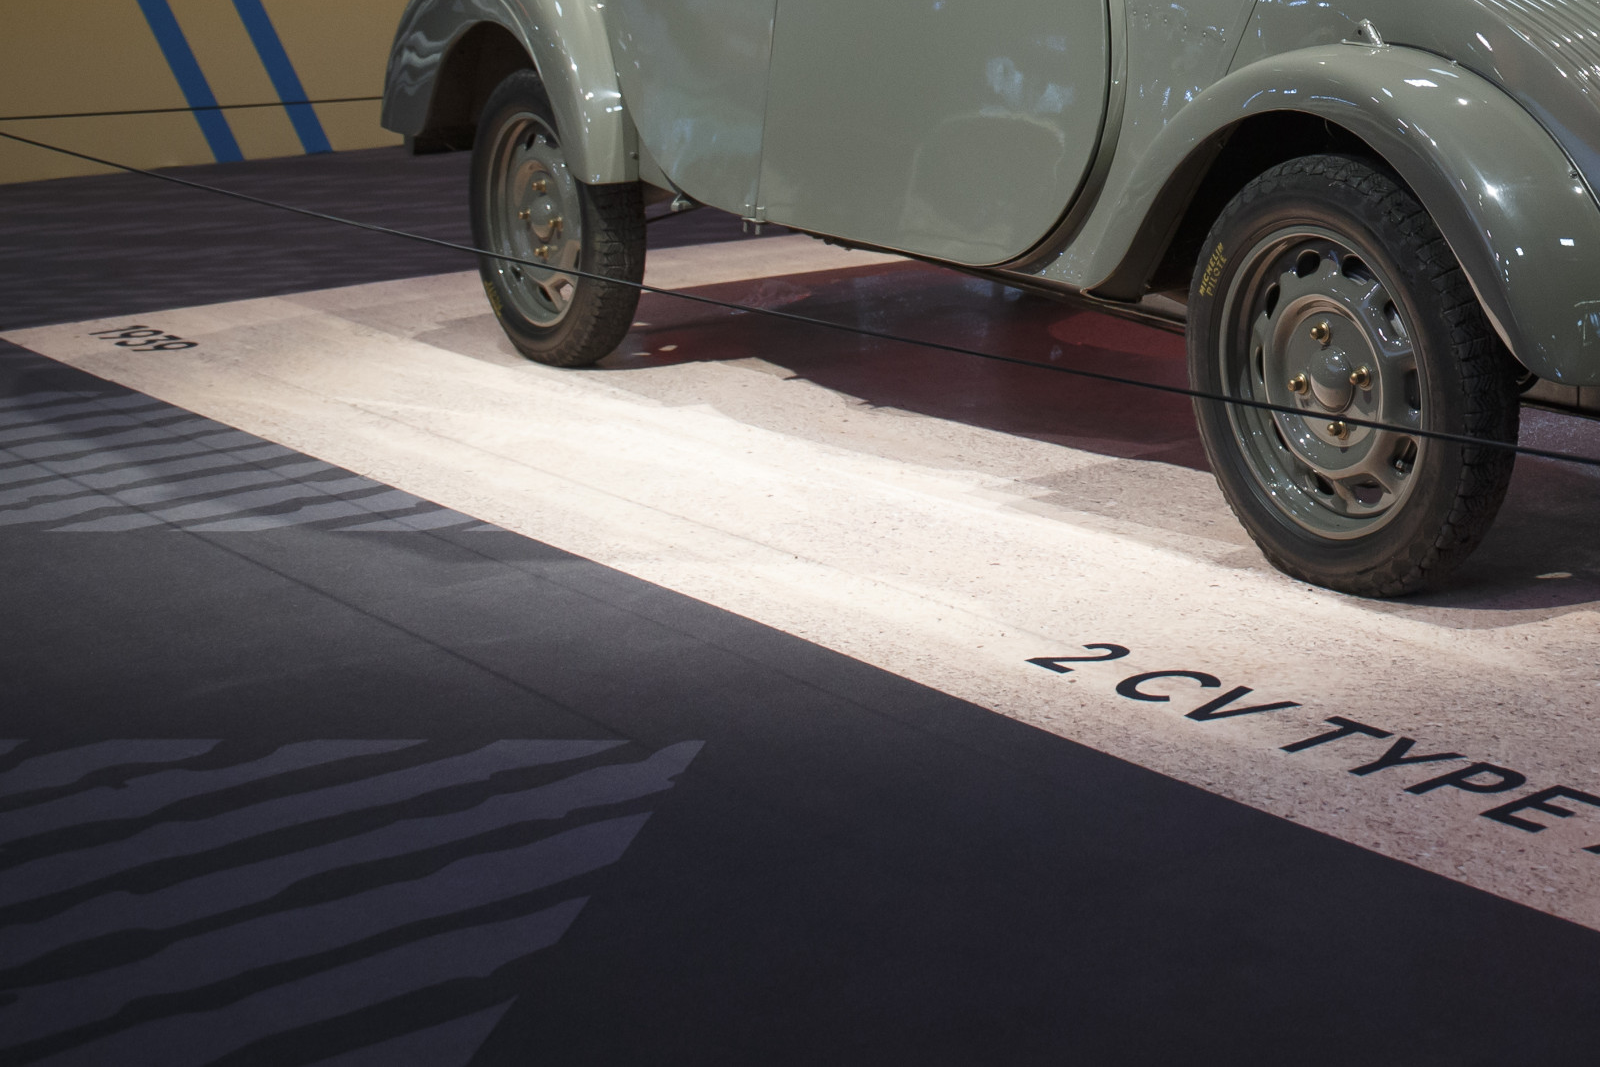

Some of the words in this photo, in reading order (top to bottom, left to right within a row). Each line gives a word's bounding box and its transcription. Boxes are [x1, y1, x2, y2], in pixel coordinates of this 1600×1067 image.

[1199, 242, 1224, 296] MICHELIN
[1206, 254, 1228, 297] PILOTE
[88, 325, 199, 352] 1939
[1025, 642, 1131, 674] 2
[1115, 669, 1304, 722] CV
